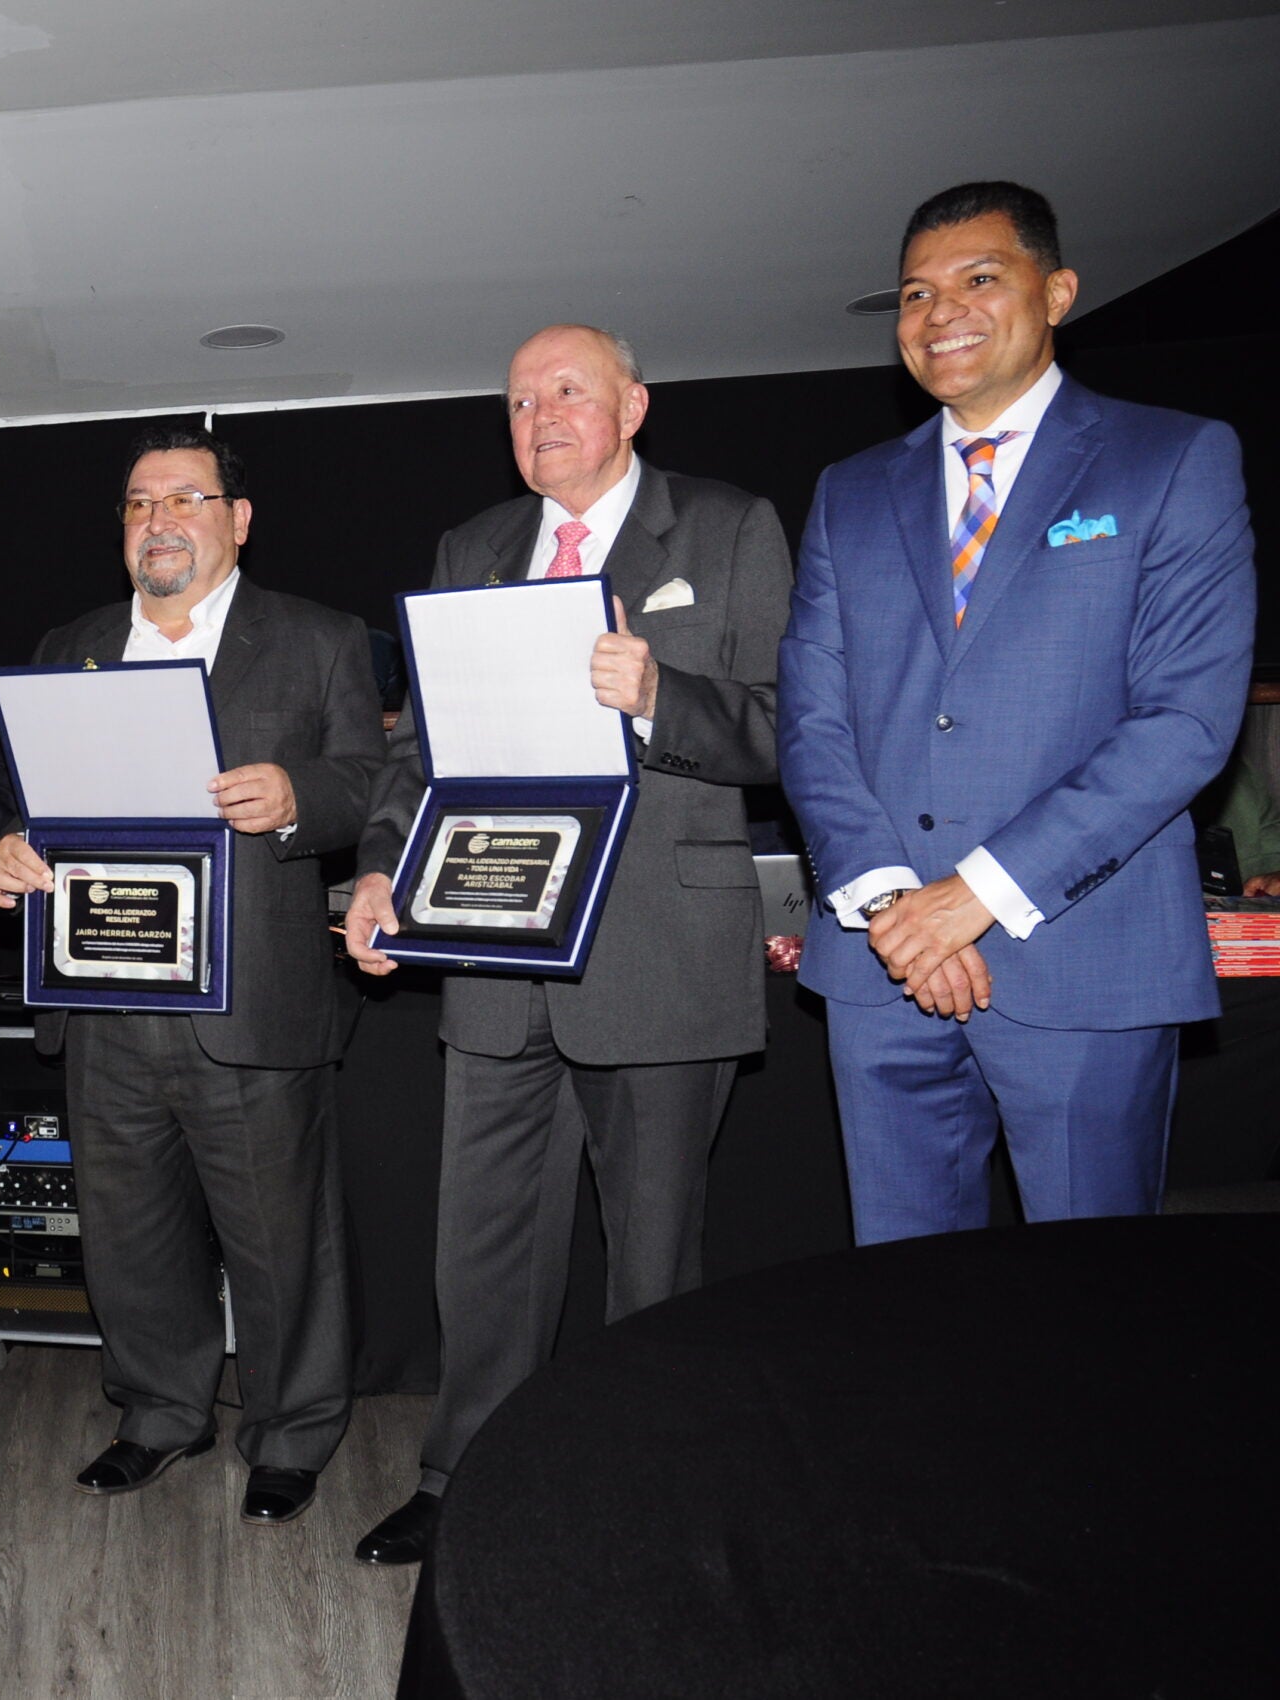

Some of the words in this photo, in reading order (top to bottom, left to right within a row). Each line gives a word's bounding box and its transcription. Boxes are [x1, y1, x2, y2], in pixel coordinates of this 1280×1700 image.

[491, 838, 540, 846] camacero
[510, 858, 551, 866] EMPRESARIAL
[457, 873, 488, 881] RAMIRO
[489, 874, 527, 883] ESCOBAR
[111, 888, 159, 896] camacero
[783, 892, 804, 913] hp
[122, 909, 158, 917] LIDERAZGO
[105, 916, 141, 924] RESILIENTE
[75, 928, 98, 936] JAIRO
[100, 929, 137, 937] HERRERA
[138, 930, 172, 938] GARZÓN
